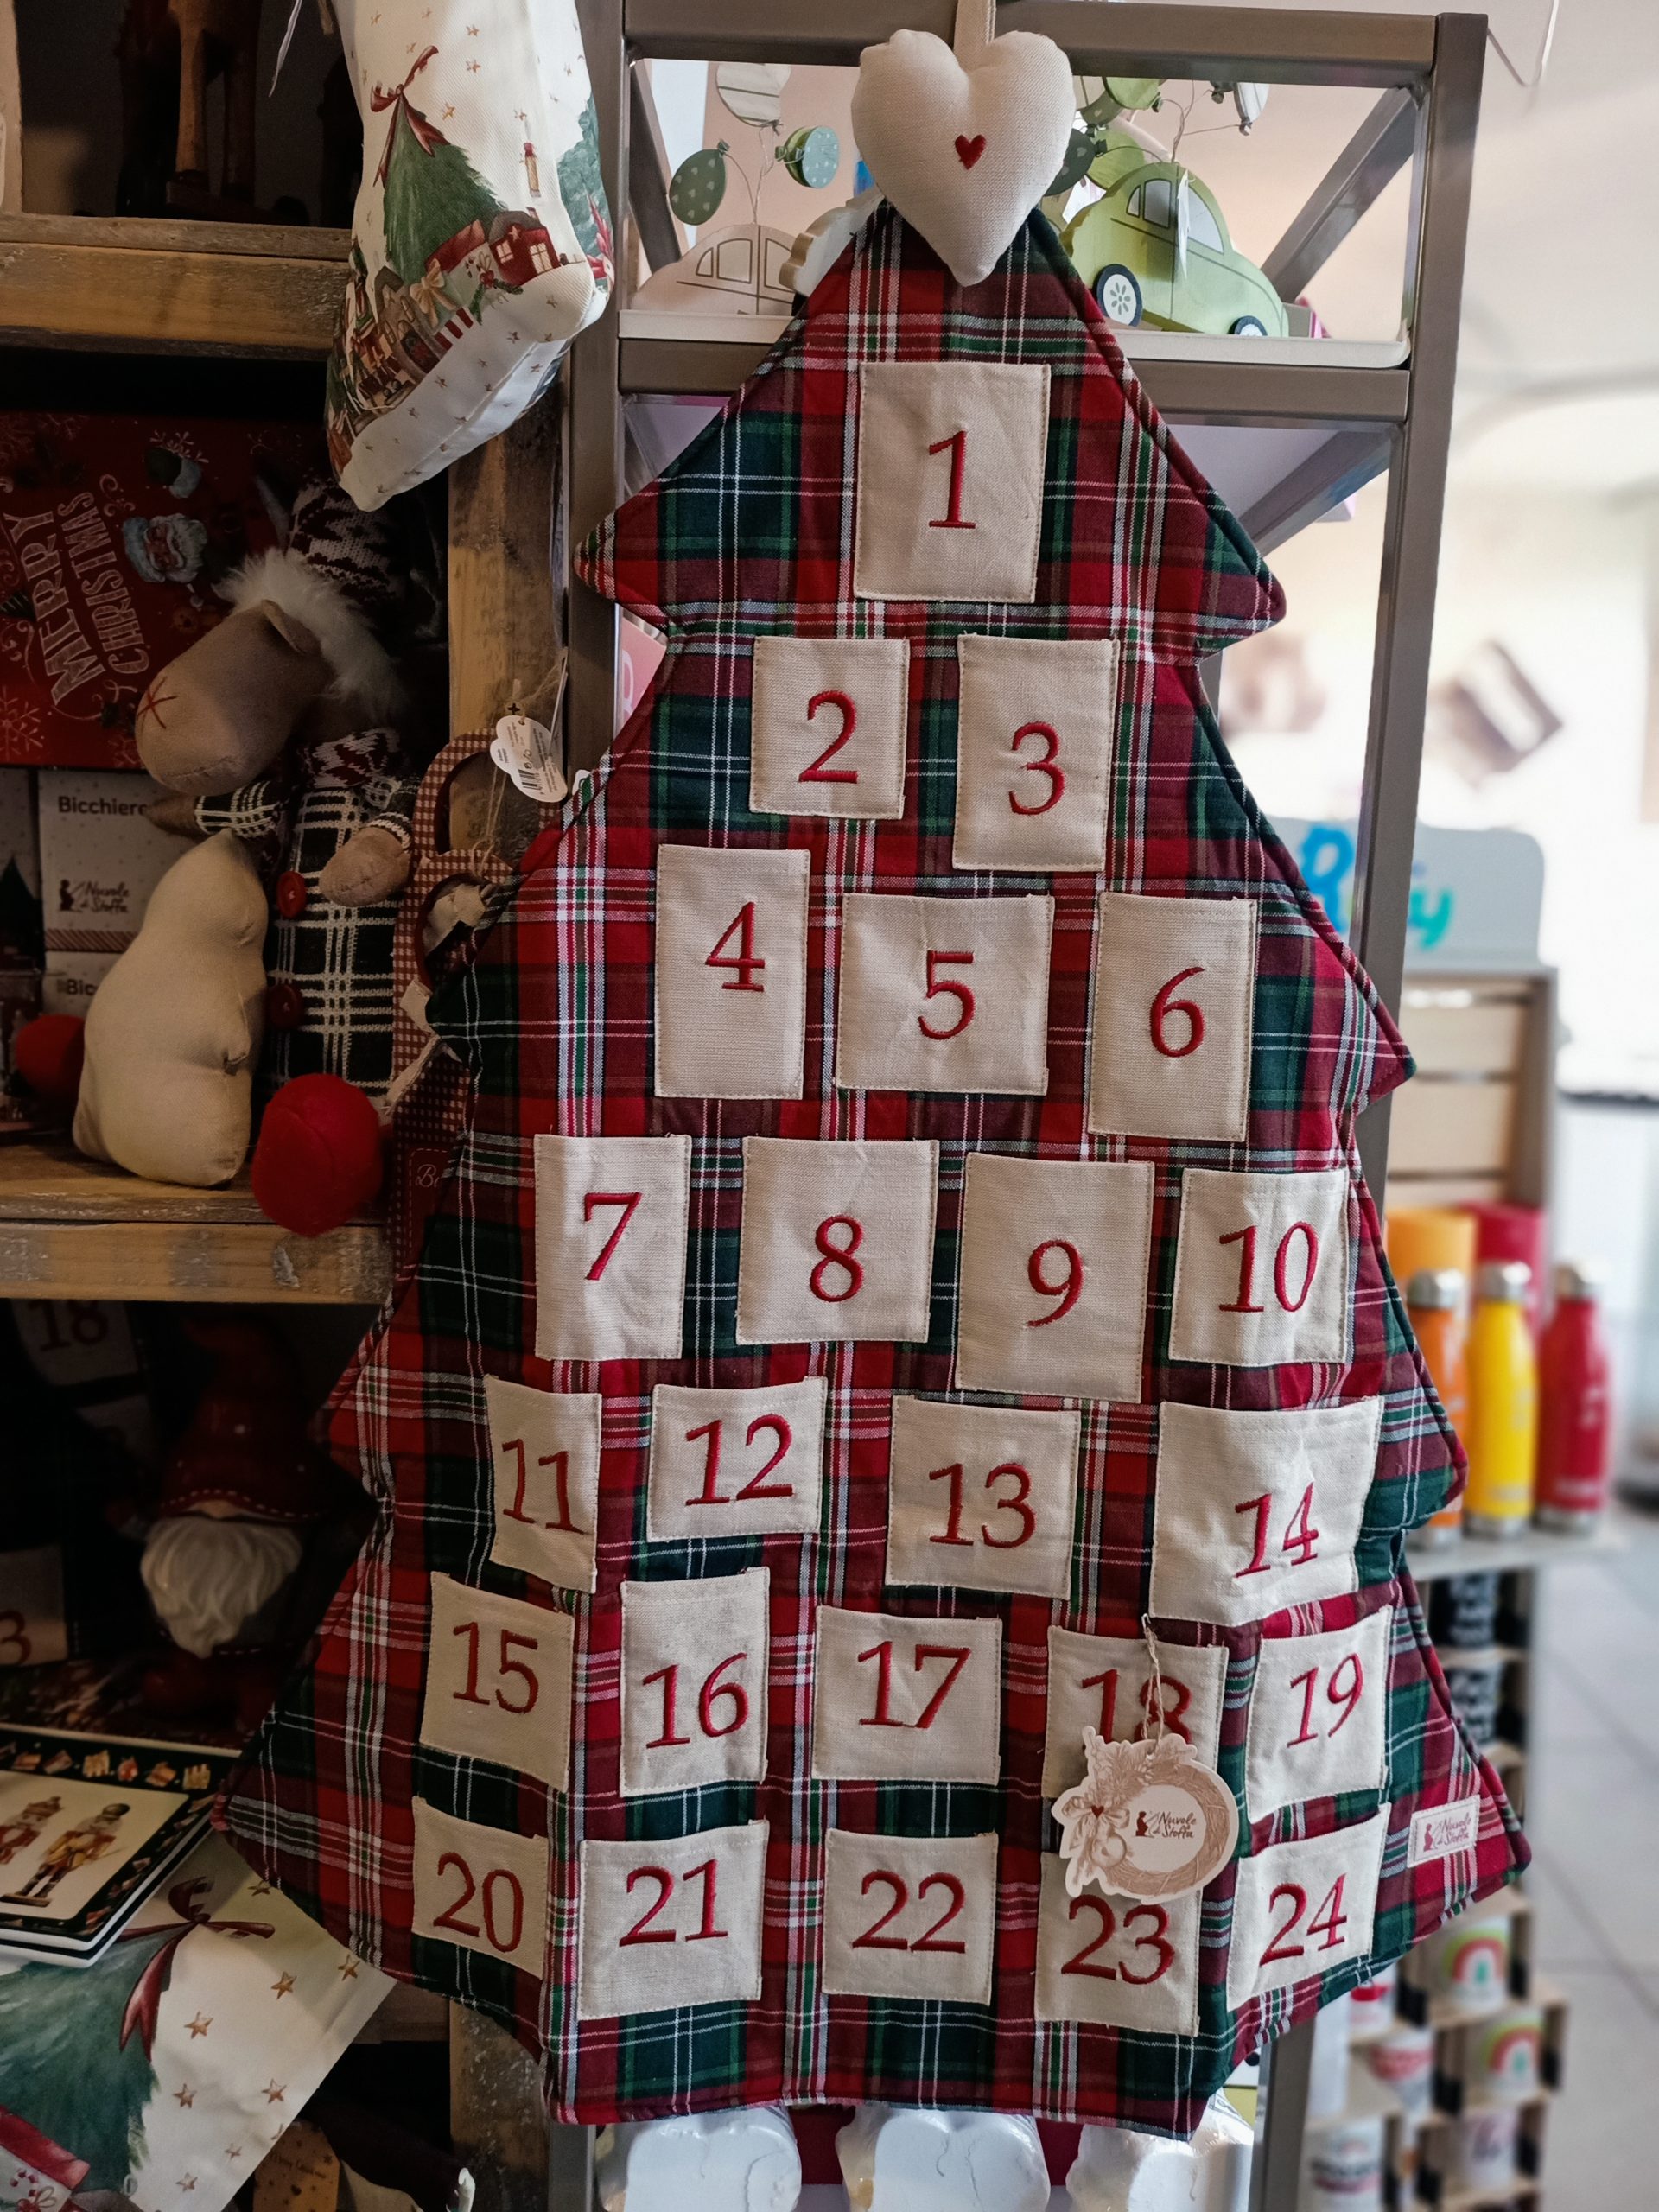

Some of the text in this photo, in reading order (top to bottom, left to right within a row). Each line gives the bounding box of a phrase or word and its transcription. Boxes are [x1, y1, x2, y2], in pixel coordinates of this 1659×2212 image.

[928, 430, 976, 530] 1
[3, 491, 149, 706] MERRY CHRISTMAS
[798, 690, 859, 785] 2
[1008, 721, 1065, 817] 3
[705, 901, 766, 993] 4
[918, 950, 976, 1041] 5
[1148, 967, 1205, 1058] 6
[583, 1192, 642, 1281] 7
[809, 1215, 864, 1303] 8
[1218, 1222, 1319, 1313] 10
[1027, 1239, 1084, 1328] 9
[502, 1439, 583, 1535] 11
[684, 1414, 794, 1506] 12
[928, 1462, 1036, 1549] 13
[1234, 1481, 1319, 1578] 14
[453, 1621, 539, 1713] 15
[642, 1652, 749, 1749] 16
[857, 1640, 971, 1729] 17
[1287, 1653, 1363, 1748] 19
[1159, 1811, 1196, 1825] Nuvole
[1161, 1824, 1193, 1839] Stoffa
[433, 1853, 523, 1953] 20
[618, 1859, 728, 1946] 21
[852, 1869, 966, 1954] 22
[1061, 1895, 1175, 1985] 23
[1260, 1873, 1347, 1967] 24
